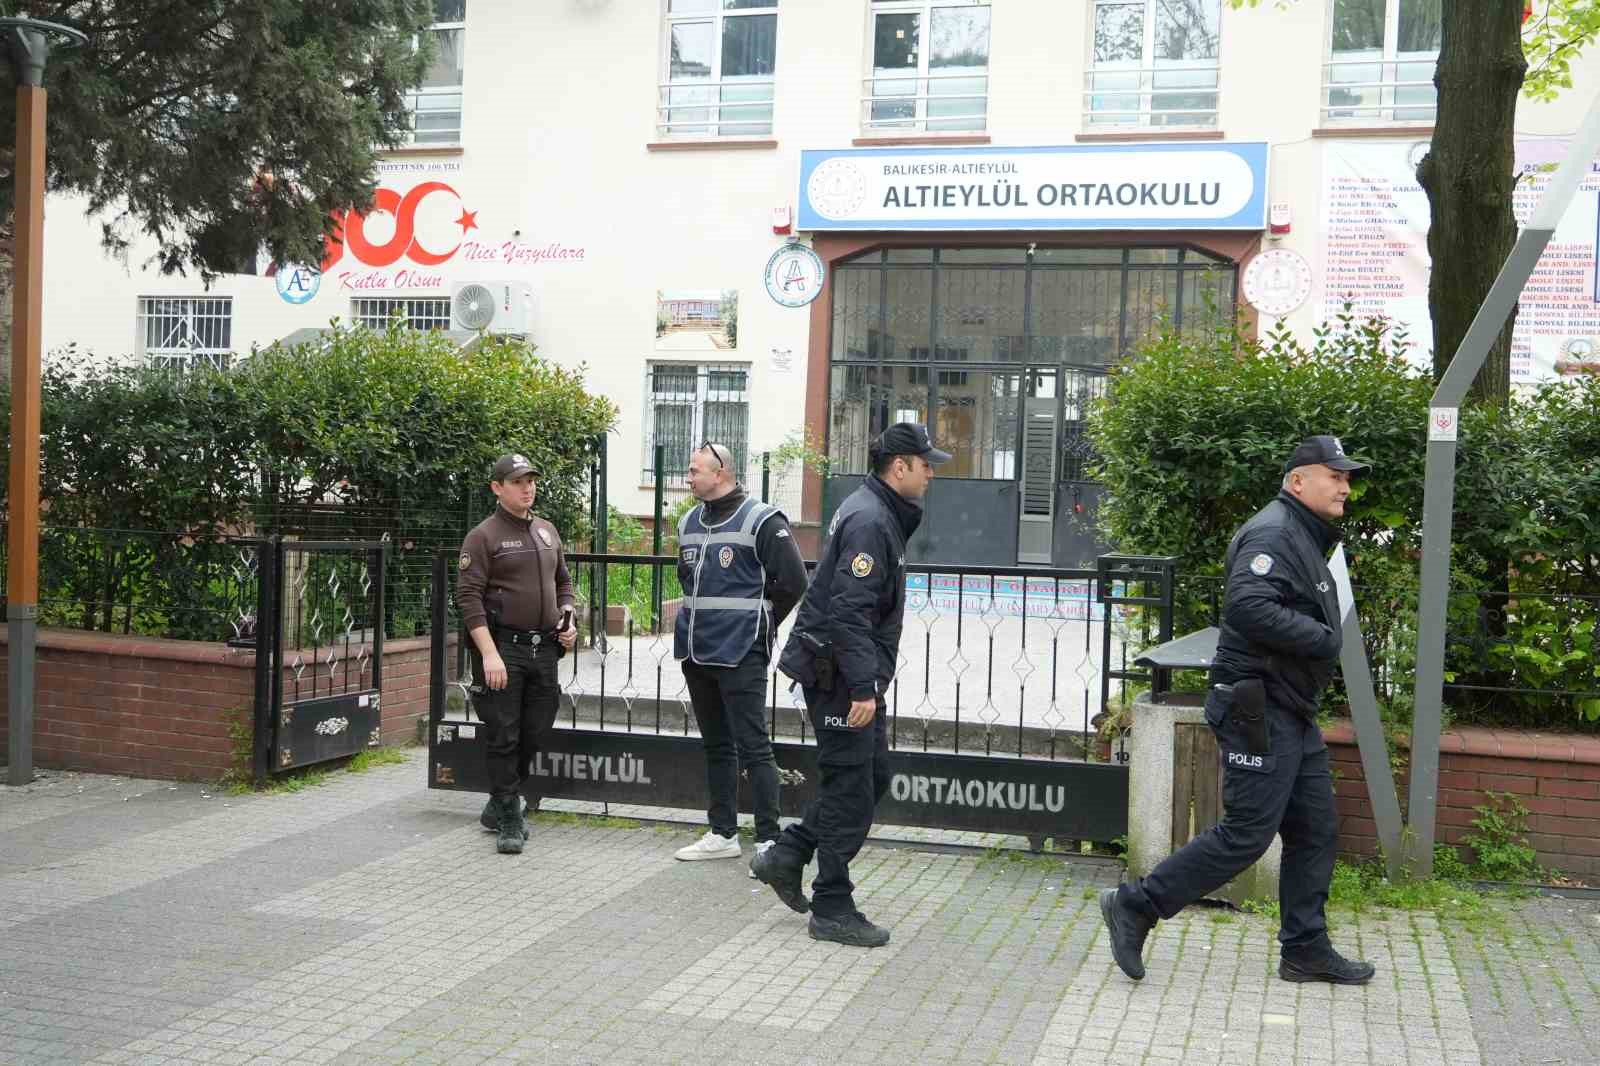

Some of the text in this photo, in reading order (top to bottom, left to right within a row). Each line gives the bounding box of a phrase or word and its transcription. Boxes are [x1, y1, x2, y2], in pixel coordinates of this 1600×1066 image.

[883, 161, 1019, 176] BALIKESİR-ALTIEYLÜL
[883, 179, 1221, 208] ALTIEYLÜL ORTAOKULU
[463, 240, 586, 264] Nice Yüzyıllara
[338, 269, 442, 290] Kutlu Olsun
[890, 774, 1065, 813] ORTAOKULU
